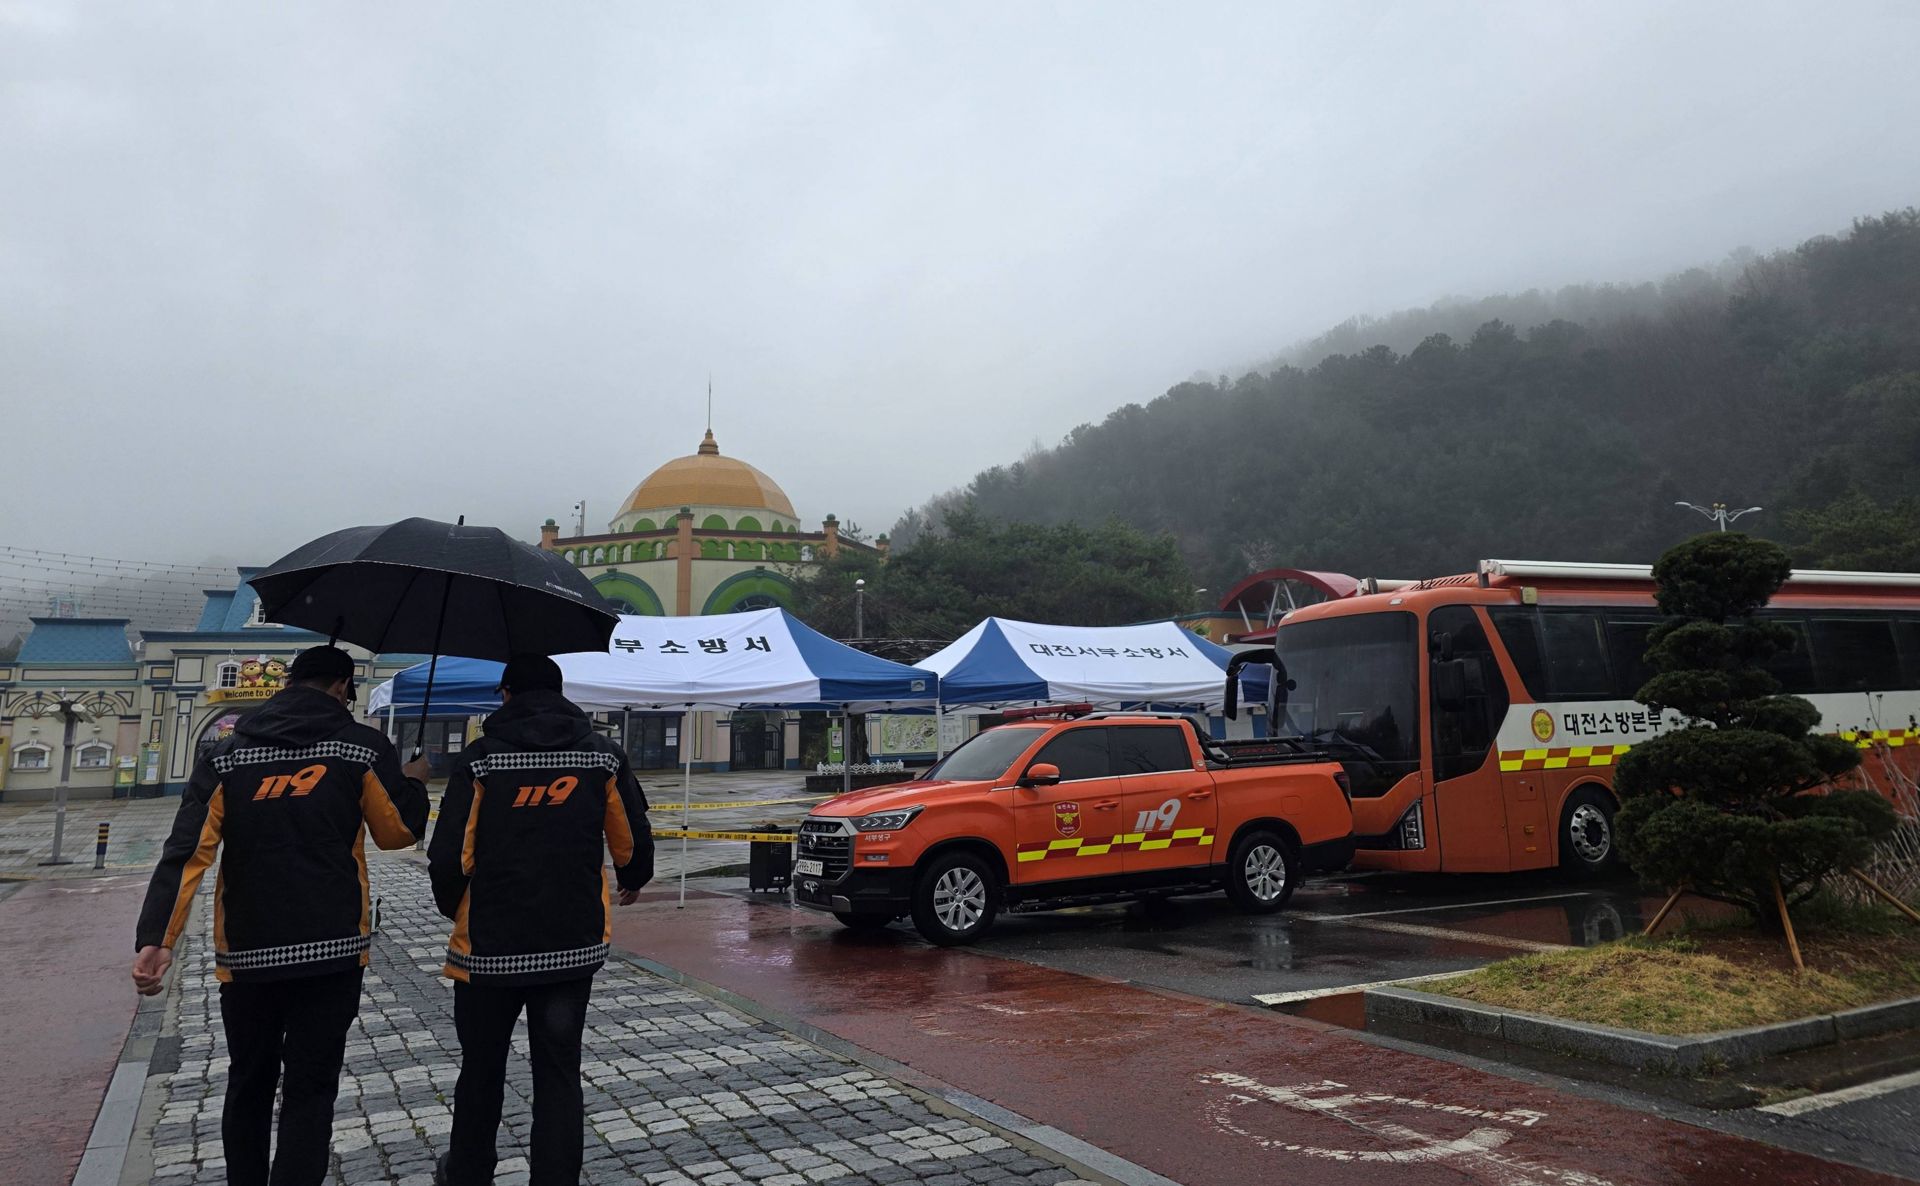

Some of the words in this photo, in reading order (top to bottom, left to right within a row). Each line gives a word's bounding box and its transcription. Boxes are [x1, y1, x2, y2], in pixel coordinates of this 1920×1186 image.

[1028, 643, 1189, 659] 대전서부소방서
[224, 689, 254, 698] Welcome
[1563, 711, 1662, 736] 대전소방본부
[252, 764, 327, 800] 119
[511, 775, 579, 807] 119
[1134, 798, 1182, 832] 119
